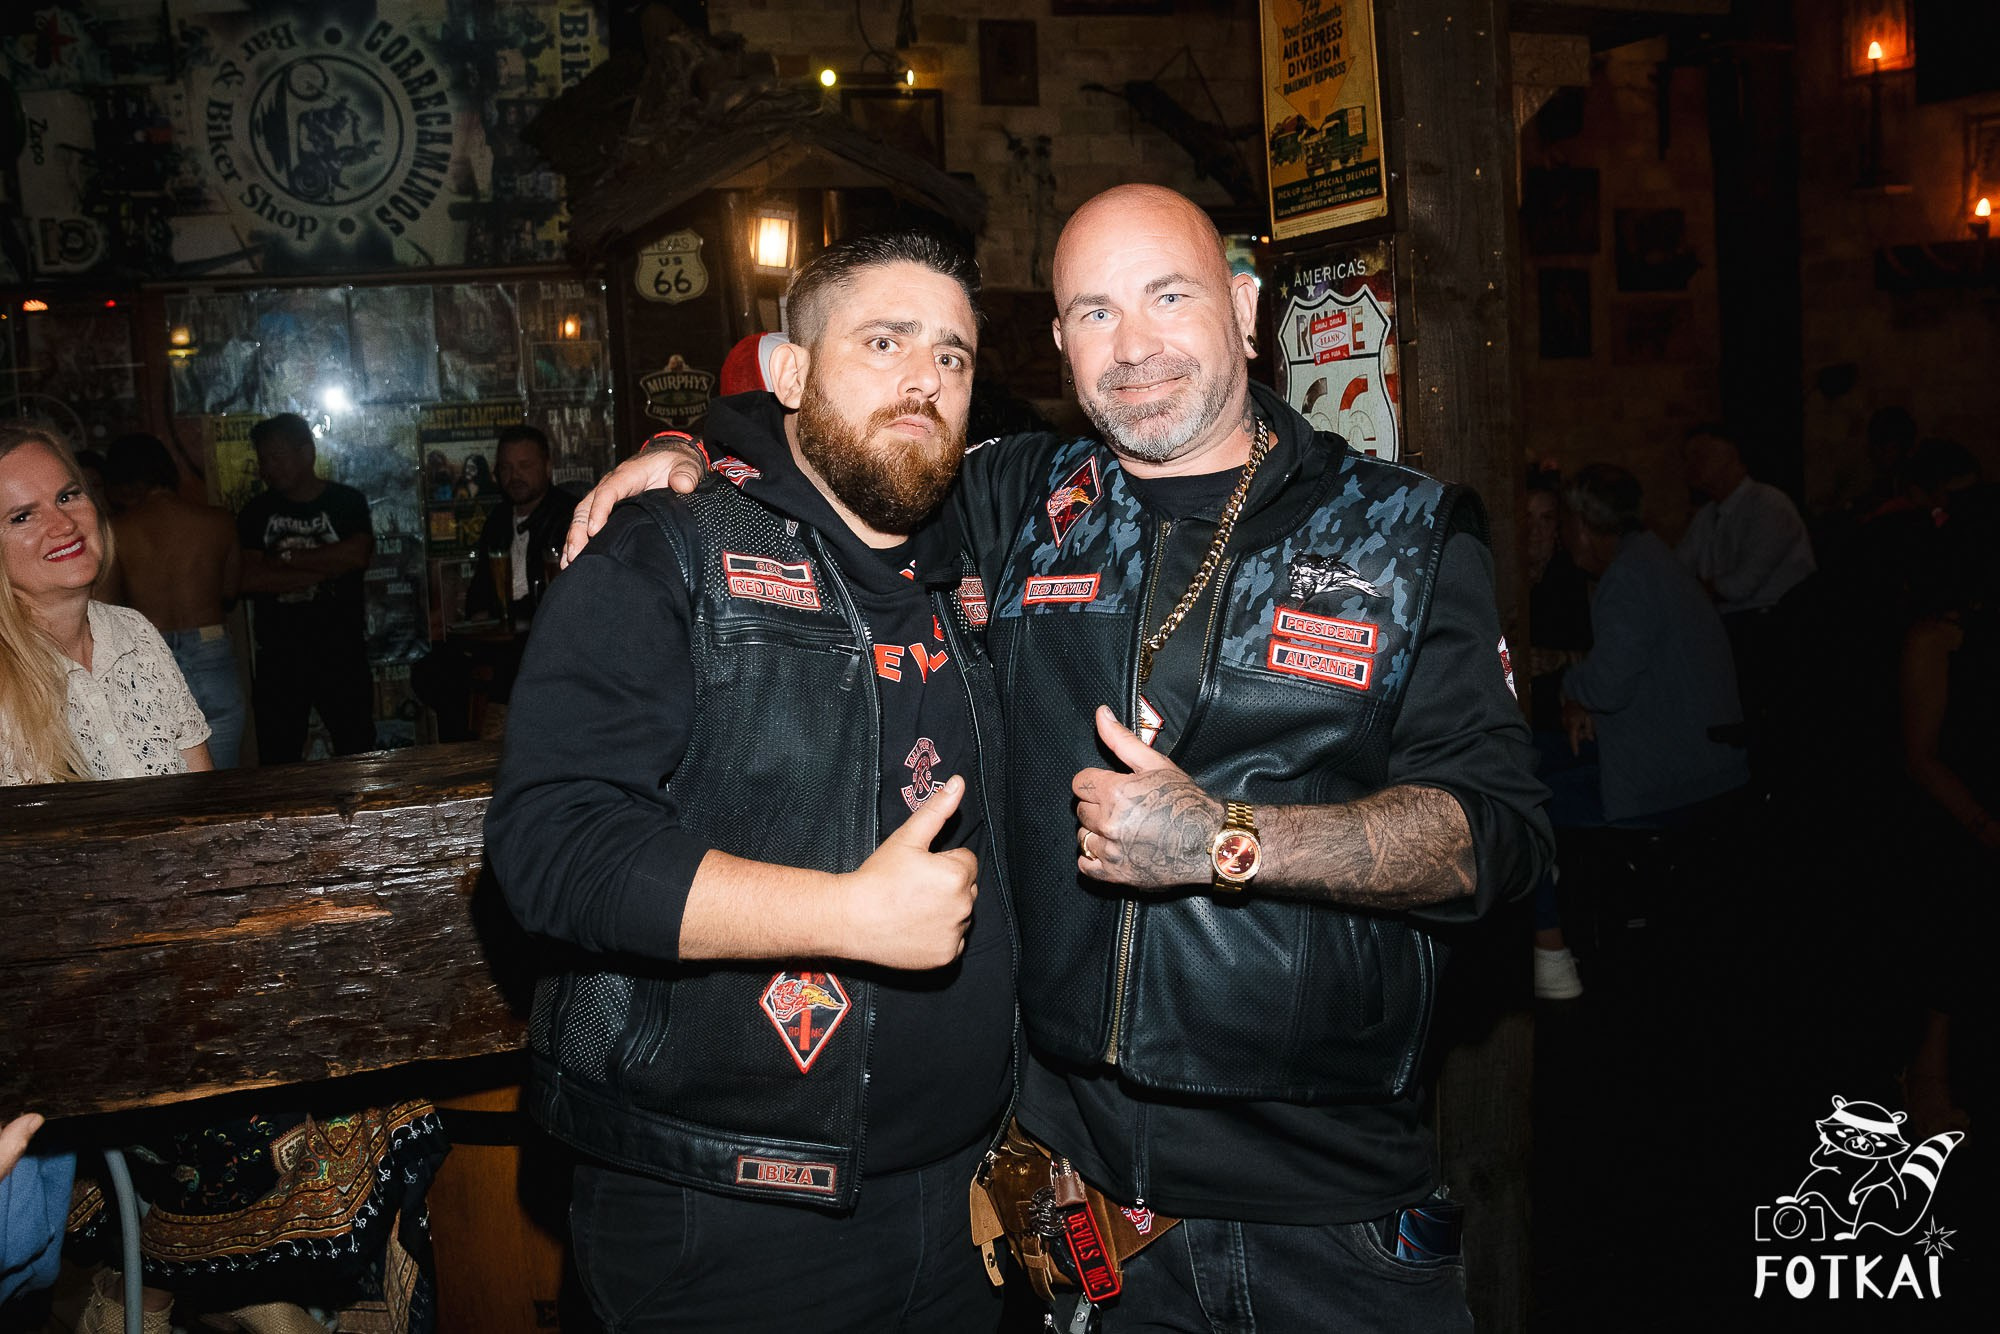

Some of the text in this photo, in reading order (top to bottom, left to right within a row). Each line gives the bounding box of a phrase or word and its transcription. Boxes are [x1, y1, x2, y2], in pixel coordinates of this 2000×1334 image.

[1283, 20, 1343, 61] AIR EXPRESS
[1287, 43, 1341, 78] DIVISION
[1283, 61, 1347, 96] RAILWAY EXPRESS
[207, 22, 318, 241] Bar & Biker Shop
[364, 20, 453, 237] CORRECAMINOS
[1314, 176, 1344, 189] SPECIAL
[1345, 166, 1379, 182] DELIVERY
[654, 269, 692, 295] 66
[1293, 259, 1366, 288] AMERICA'S
[1296, 305, 1365, 357] ROE
[735, 580, 814, 604] RED DEVILS
[1031, 582, 1091, 596] RED DEVILS
[1285, 616, 1365, 642] PRESIDENT
[1284, 651, 1357, 679] ALICANTE
[757, 1163, 814, 1185] IBIZA
[1067, 1210, 1112, 1292] DEVILS MC
